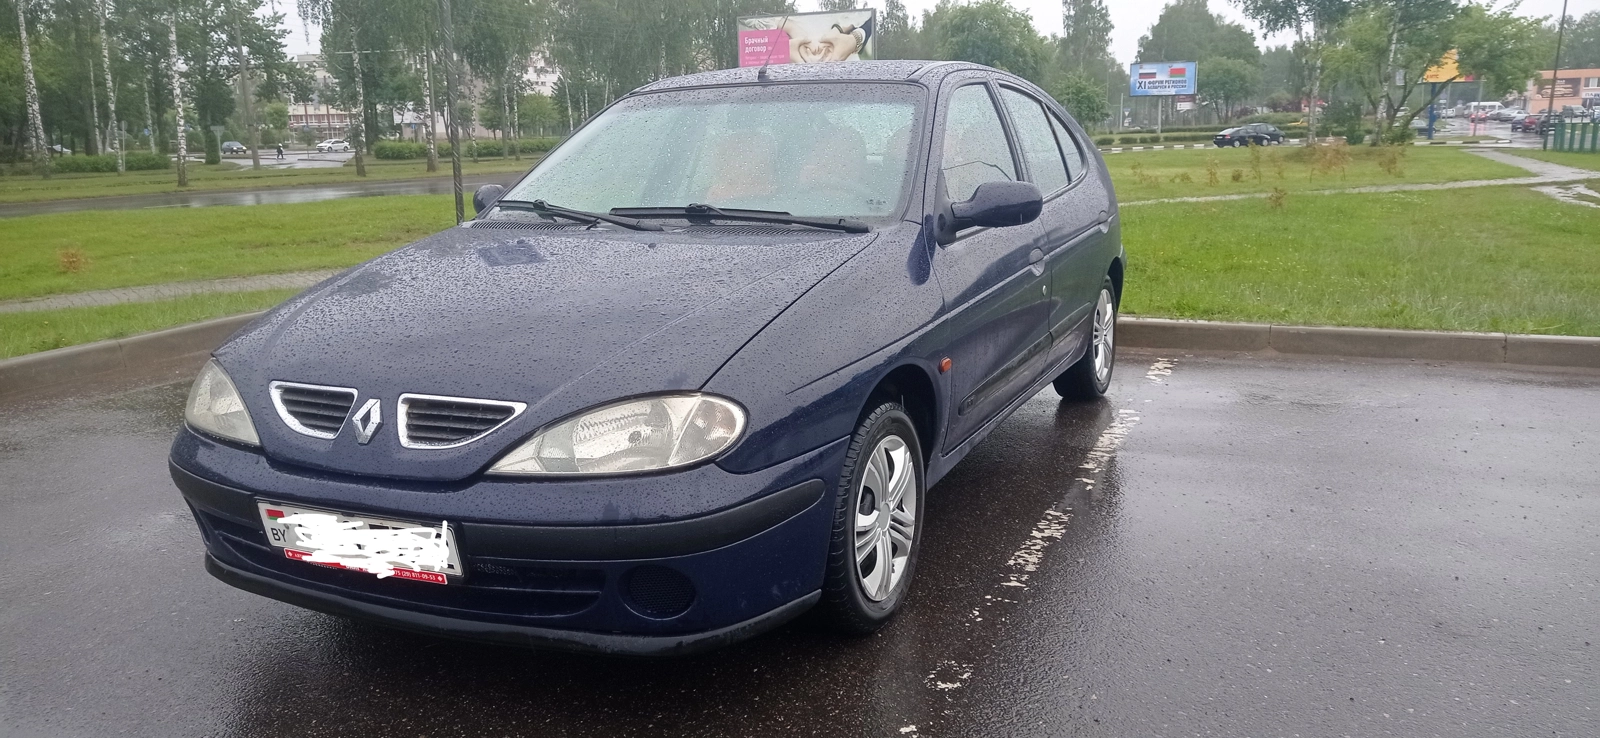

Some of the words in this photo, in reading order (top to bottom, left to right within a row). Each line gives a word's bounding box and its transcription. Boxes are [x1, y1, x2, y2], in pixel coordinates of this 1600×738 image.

[744, 36, 768, 45] Брачный
[1137, 80, 1147, 90] XI
[271, 528, 286, 542] BY
